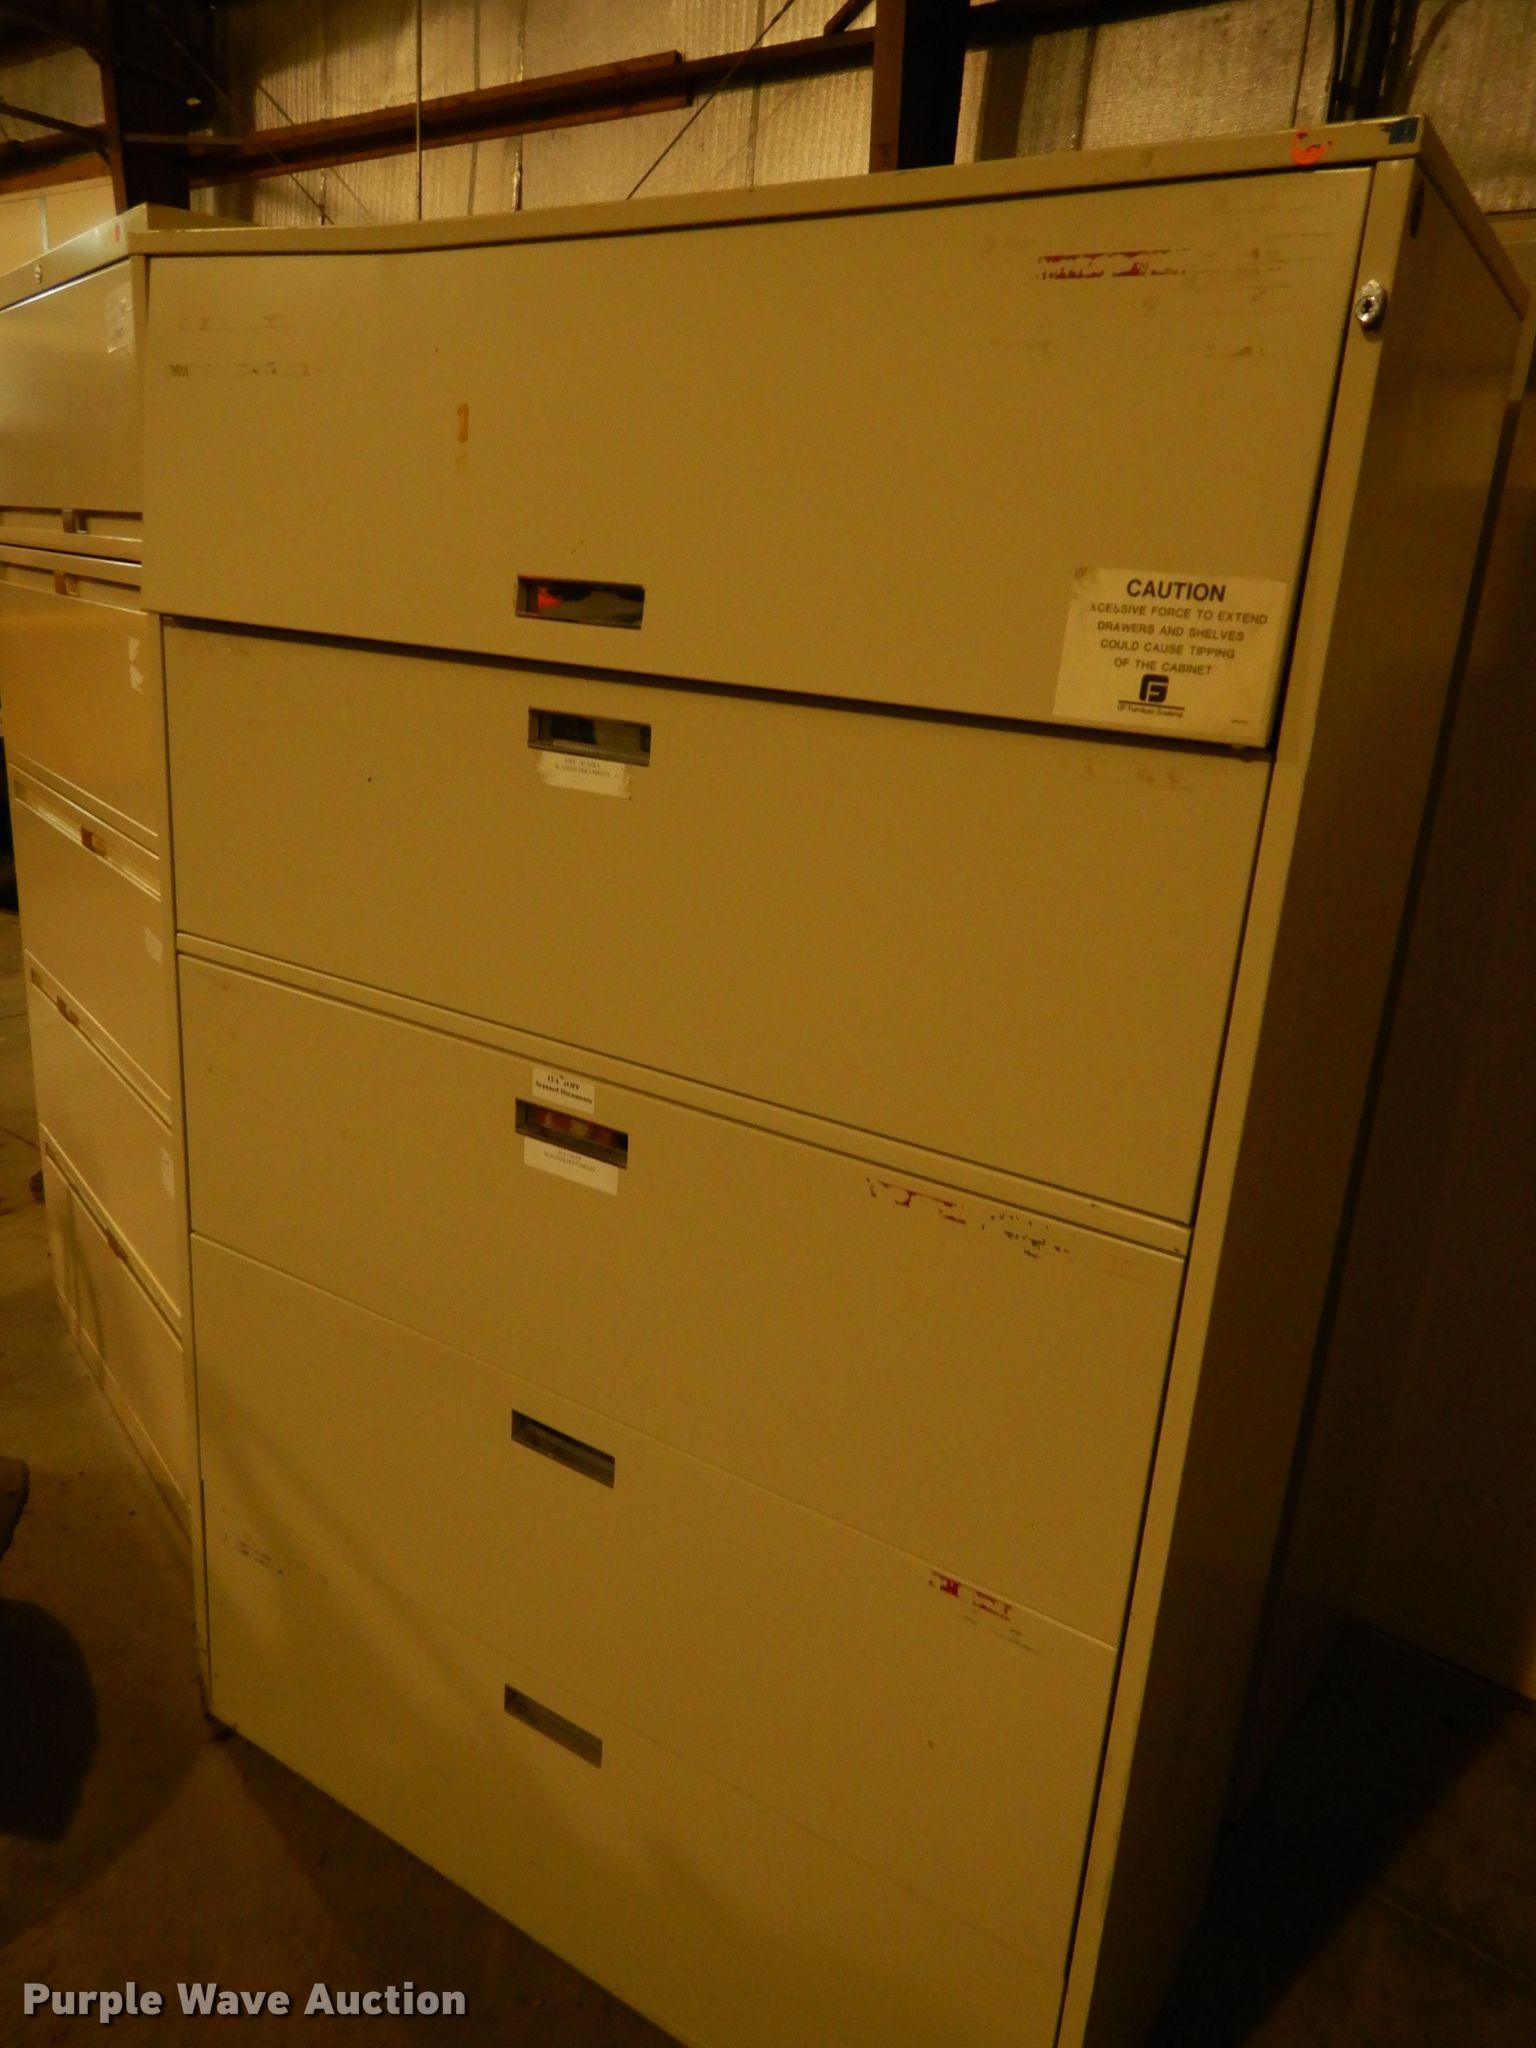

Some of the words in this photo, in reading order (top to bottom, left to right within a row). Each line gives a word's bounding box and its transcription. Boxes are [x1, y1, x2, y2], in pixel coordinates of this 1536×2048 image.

[1126, 579, 1226, 602] CAUTION
[1089, 602, 1146, 616] XCESSIVE
[1151, 607, 1191, 619] FORCE
[1197, 609, 1213, 620] TO
[1217, 610, 1268, 625] EXTEND
[1097, 620, 1155, 635] DRAWERS
[1159, 626, 1184, 637] AND
[1188, 628, 1244, 642] SHELVES
[1100, 638, 1139, 651] COULD
[1144, 642, 1184, 655] CAUSE
[1190, 645, 1235, 659] TIPPING
[1114, 657, 1130, 668] OF
[1135, 659, 1157, 671] THE
[1161, 662, 1213, 675] CABINET
